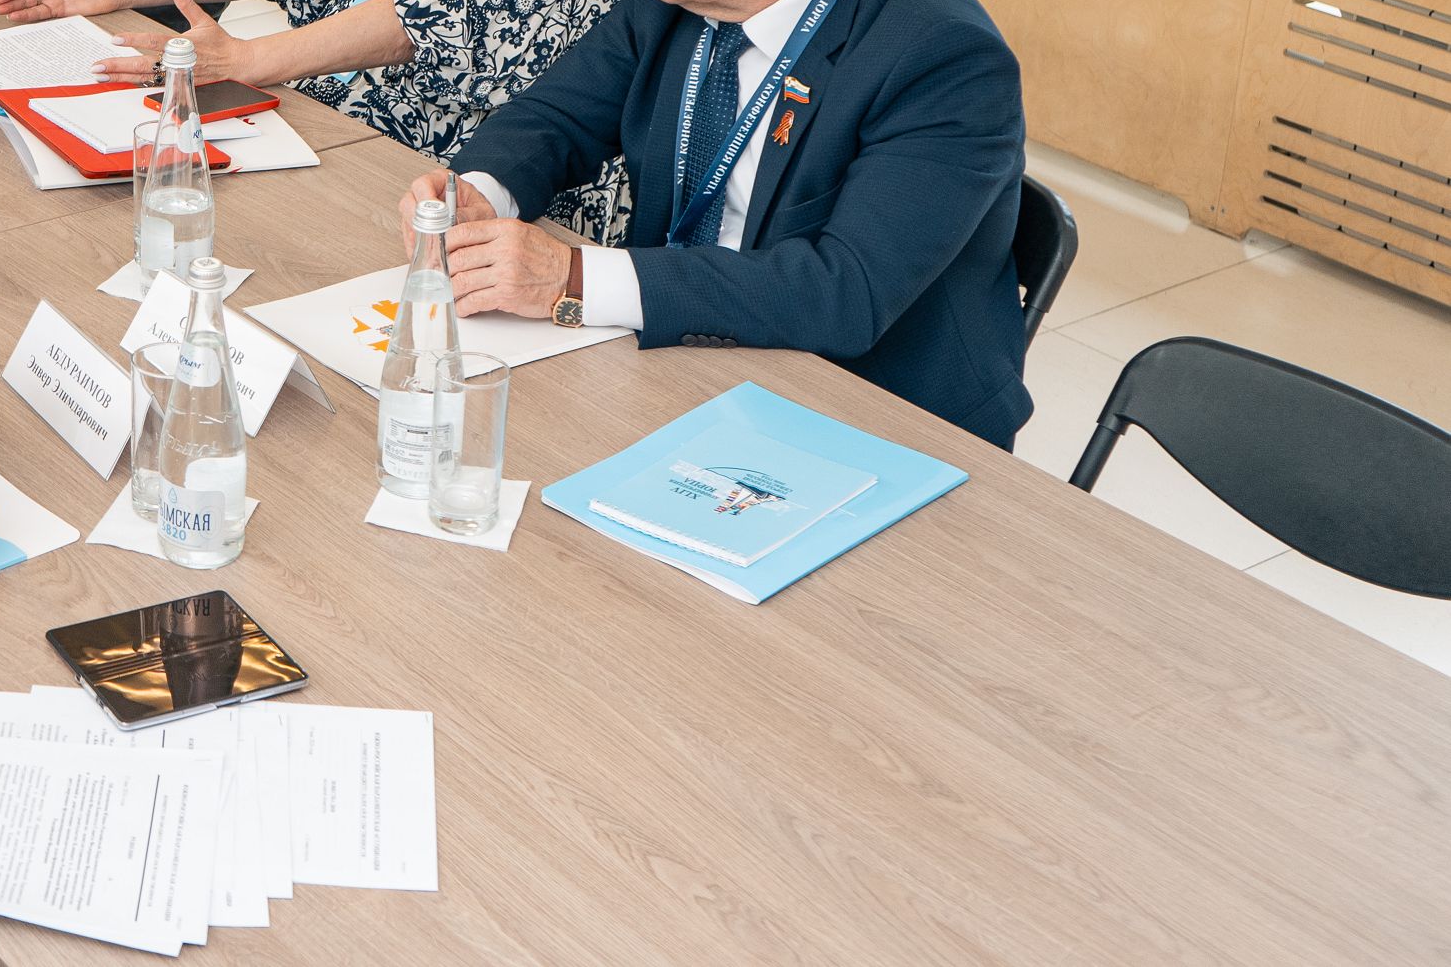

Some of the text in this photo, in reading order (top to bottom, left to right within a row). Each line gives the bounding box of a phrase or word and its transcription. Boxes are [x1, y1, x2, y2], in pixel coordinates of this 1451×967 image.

[800, 0, 829, 34] ЮРПА
[679, 64, 701, 155] КОНФЕРЕНЦИЯ
[722, 83, 775, 165] КОНФЕРЕНЦИЯ
[703, 163, 728, 195] ЮРПА
[26, 354, 52, 388] Энвер
[51, 378, 109, 441] Элимдарович
[45, 343, 112, 409] АБДУРАИМОВ
